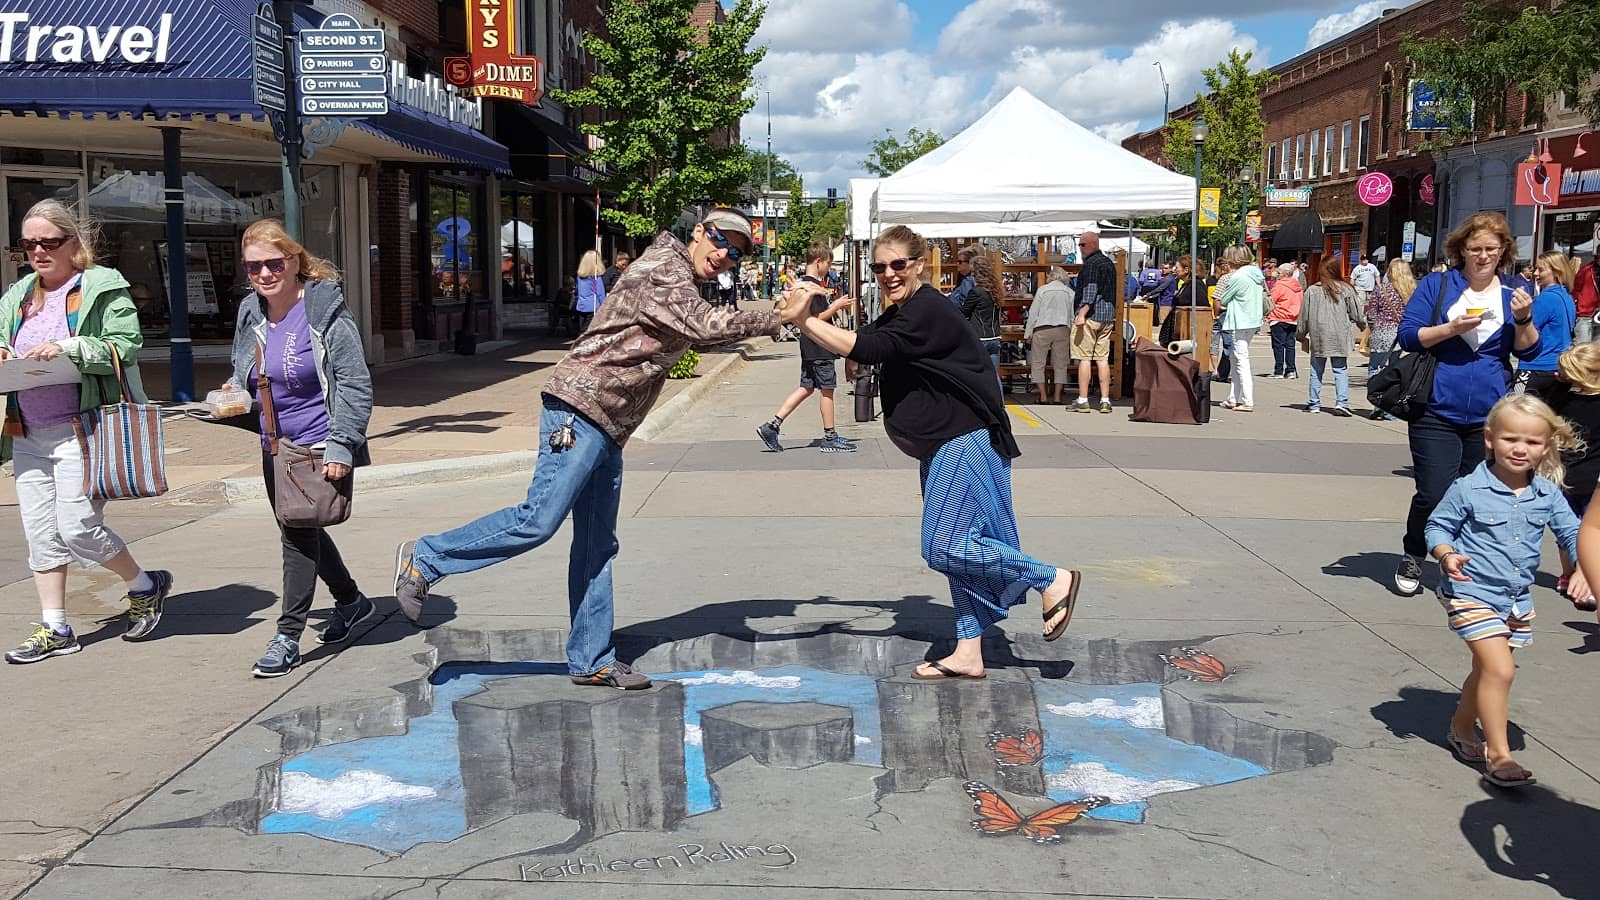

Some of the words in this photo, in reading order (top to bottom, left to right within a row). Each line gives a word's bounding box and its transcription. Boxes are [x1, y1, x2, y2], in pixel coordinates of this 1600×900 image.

[0, 12, 173, 63] Travel
[306, 36, 356, 46] SECOND
[360, 36, 378, 46] ST.
[316, 60, 354, 68] PARKING
[473, 65, 486, 80] and
[486, 62, 534, 82] DIME
[391, 60, 448, 118] Humble
[447, 84, 482, 130] Travel
[460, 85, 523, 100] TAVERN
[319, 101, 360, 110] OVERMAN
[361, 101, 385, 109] PARK
[1270, 191, 1282, 200] LOS
[1283, 190, 1306, 200] CABOS
[518, 854, 682, 881] Kathleen
